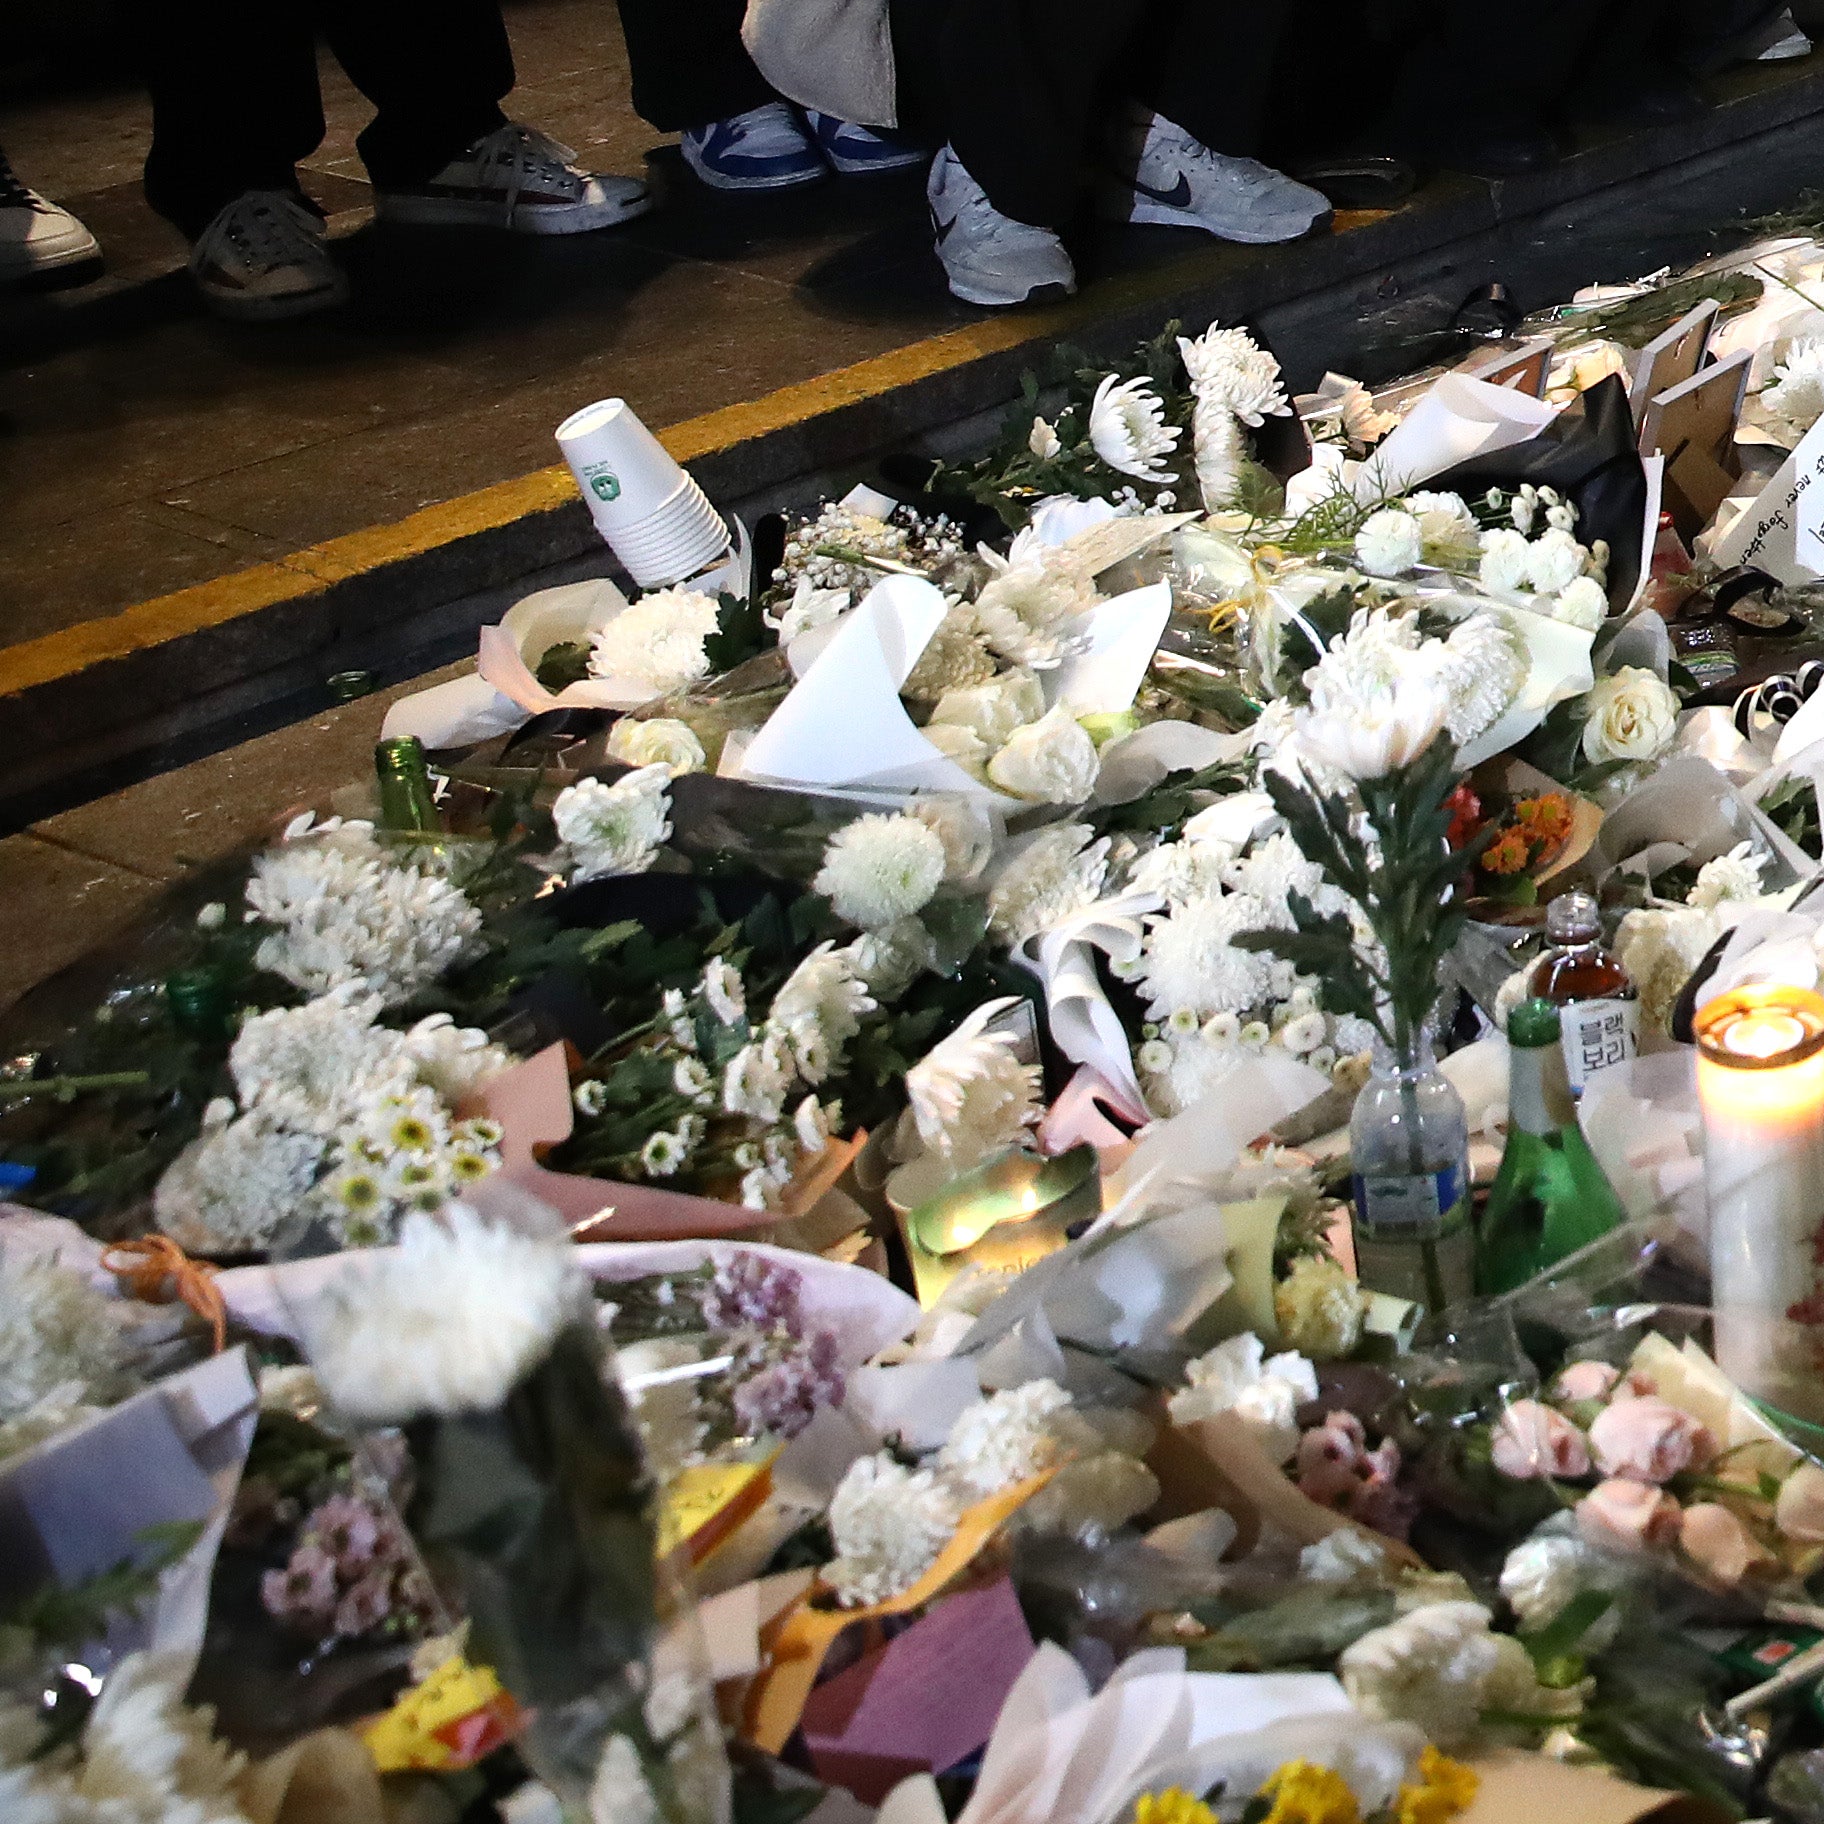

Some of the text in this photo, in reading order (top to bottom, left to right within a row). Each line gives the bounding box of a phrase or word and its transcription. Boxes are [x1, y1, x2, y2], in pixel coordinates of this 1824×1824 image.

[1785, 475, 1812, 509] never
[1739, 510, 1789, 565] forgotten
[1580, 1011, 1624, 1046] 블랙
[1582, 1037, 1626, 1072] 보리
